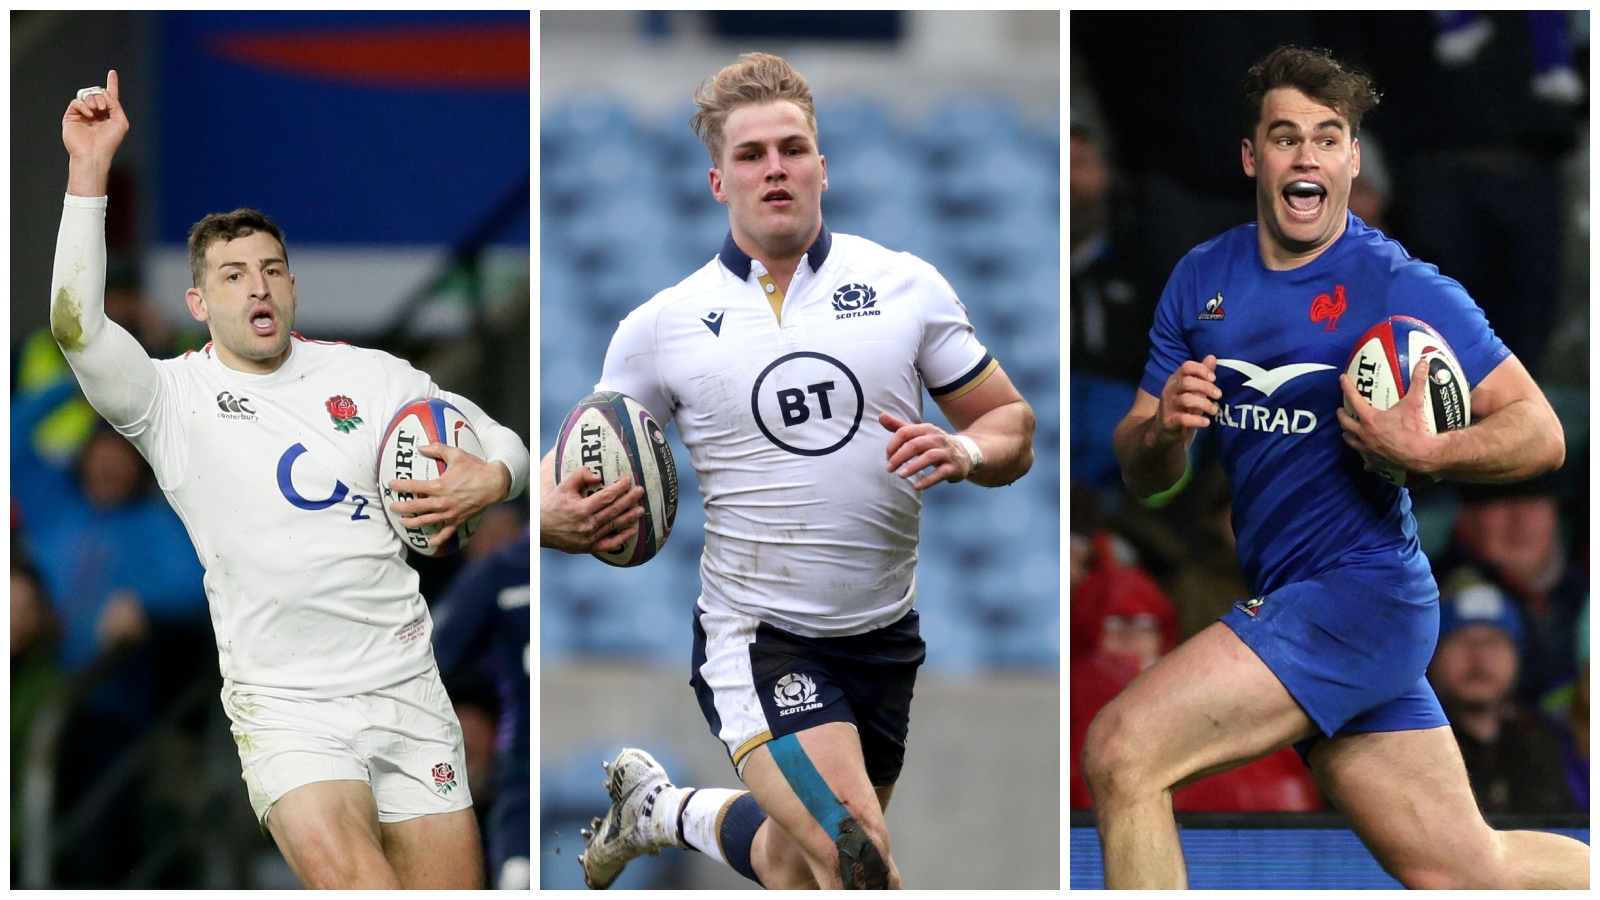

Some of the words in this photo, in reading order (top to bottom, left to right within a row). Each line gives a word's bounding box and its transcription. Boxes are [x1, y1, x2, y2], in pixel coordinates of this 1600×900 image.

[835, 310, 881, 320] SCOTLAND
[217, 412, 259, 422] canterbury
[776, 381, 835, 427] BT
[1214, 401, 1317, 434] ALTRAD
[1440, 386, 1455, 431] UINNESS
[660, 446, 674, 503] GUINNESS
[779, 702, 823, 717] SCOTLAND
